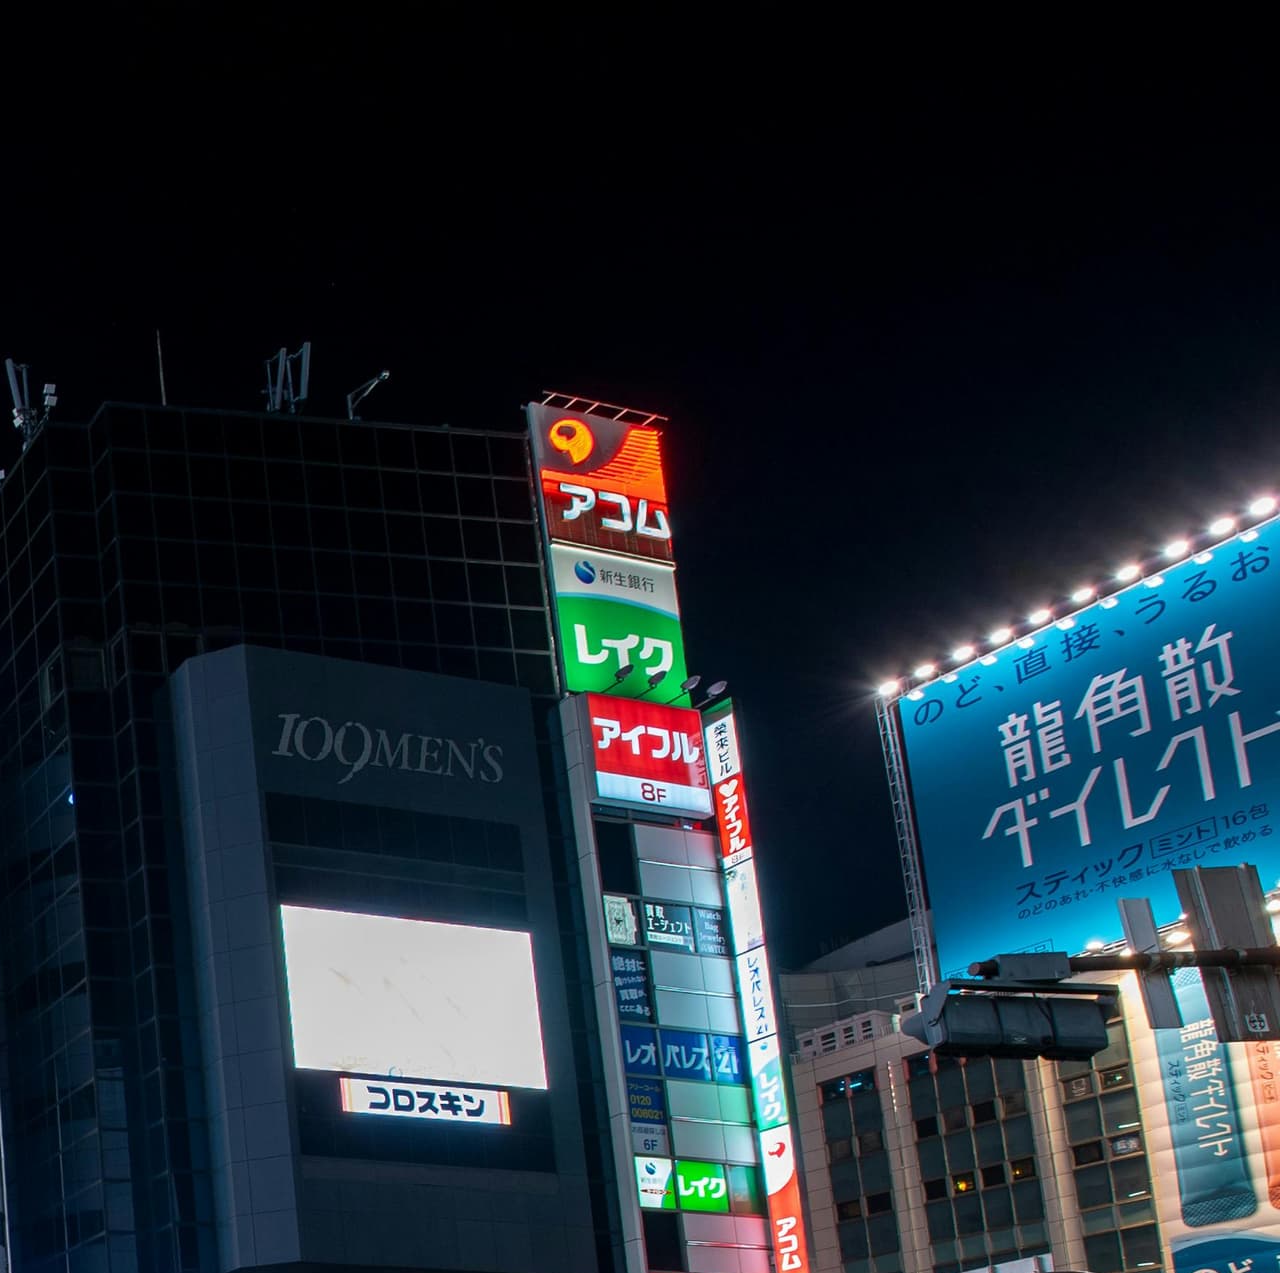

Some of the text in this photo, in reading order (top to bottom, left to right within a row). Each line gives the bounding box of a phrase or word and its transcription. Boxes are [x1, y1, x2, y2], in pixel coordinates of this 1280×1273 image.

[559, 482, 672, 540] アコム
[599, 568, 655, 593] 新生銀行
[574, 624, 674, 676] レイク
[913, 545, 1271, 727] のど、直接、うるお
[998, 623, 1243, 788] 龍角散
[593, 716, 700, 765] アイフル
[641, 782, 667, 803] 8F
[980, 710, 1280, 868] ダイレクト
[722, 793, 747, 854] アイフル
[1016, 842, 1145, 906] スティック
[647, 918, 692, 935] エージェント
[367, 1086, 485, 1118] コロスキン
[630, 1095, 652, 1106] 0120
[759, 1072, 783, 1123] レイク
[1179, 1018, 1233, 1156] 龍角散ダイレクト
[643, 1138, 658, 1151] 6F
[677, 1174, 726, 1199] レイク
[775, 1217, 802, 1272] アコム
